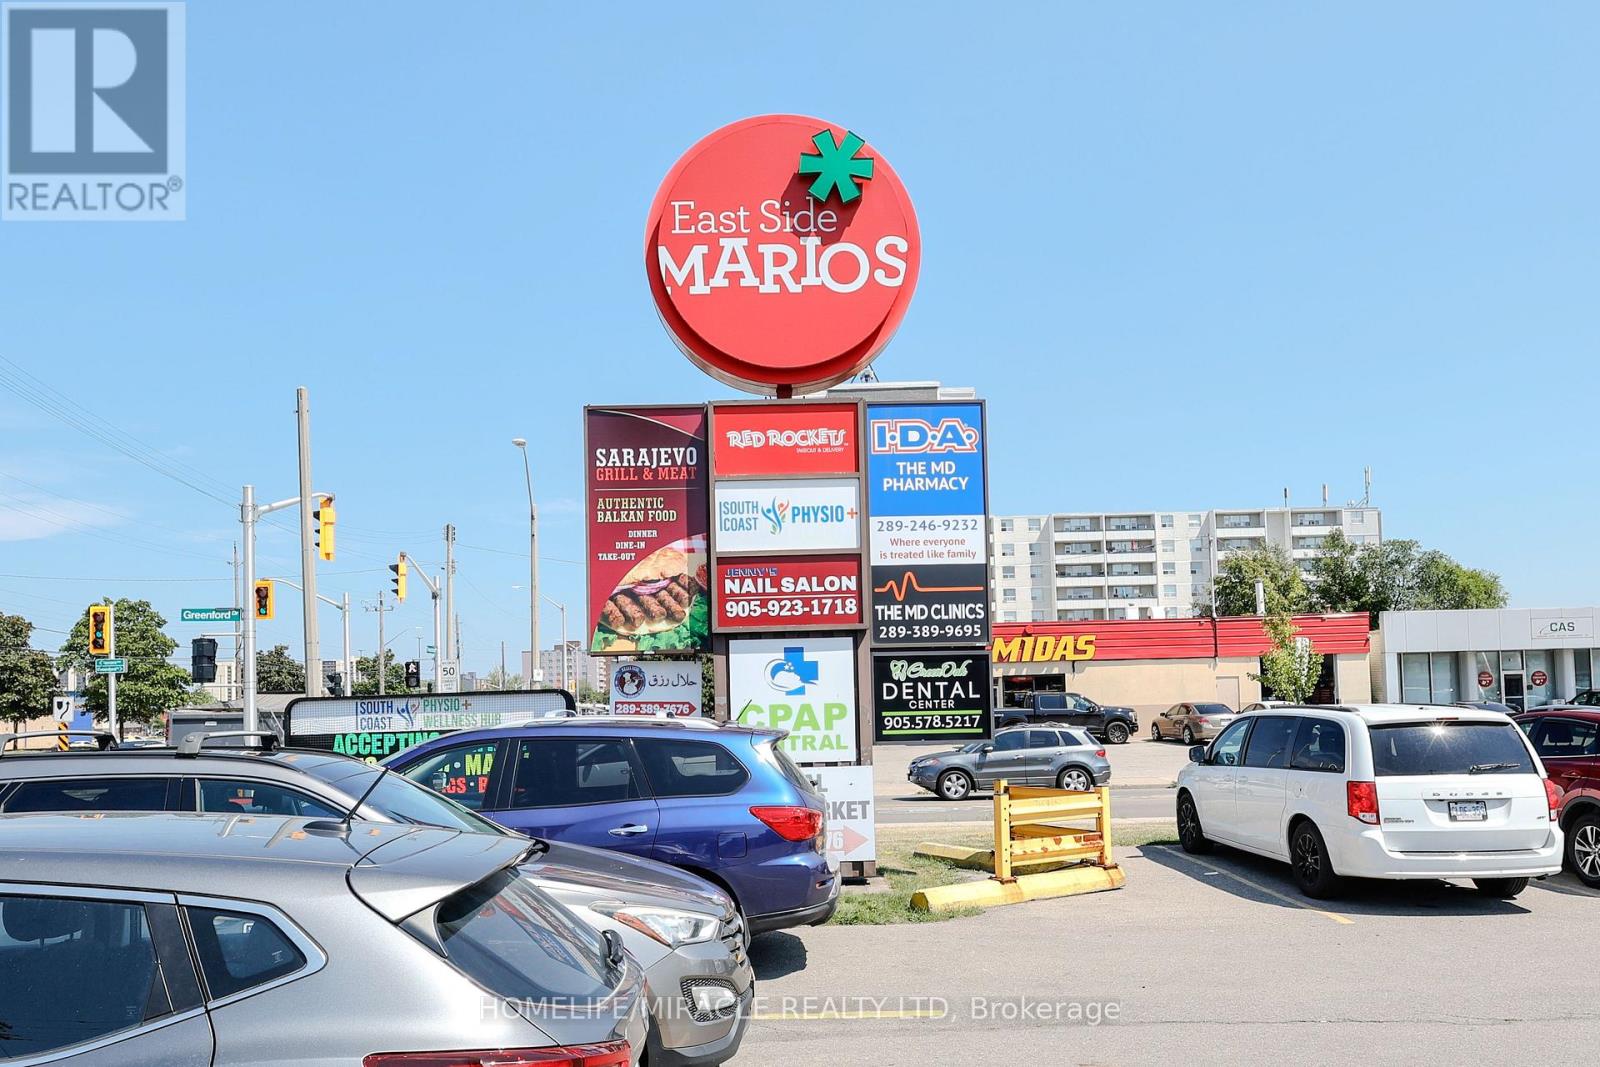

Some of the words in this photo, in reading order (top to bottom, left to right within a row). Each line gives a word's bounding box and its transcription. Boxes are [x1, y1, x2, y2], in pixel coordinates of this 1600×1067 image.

[670, 199, 751, 235] East
[759, 196, 838, 234] Side
[657, 234, 909, 296] MARIOS
[726, 429, 766, 449] RED
[766, 427, 847, 448] ROCKETS
[595, 446, 698, 470] SARAJEVO
[596, 467, 639, 481] GRILL
[642, 467, 654, 480] &
[657, 466, 697, 480] MEAT
[895, 461, 927, 475] THE
[930, 460, 956, 475] MD
[883, 476, 969, 492] PHARMACY
[596, 497, 665, 510] AUTHENTIC
[722, 501, 759, 515] SOUTH
[596, 510, 645, 523] BALKAN
[647, 510, 678, 522] FOOD
[791, 505, 845, 524] PHYSIO
[723, 517, 760, 532] COAST
[876, 519, 979, 532] 289-246-9232
[628, 530, 658, 538] DINNER
[615, 541, 646, 549] DINE-IN
[890, 538, 921, 547] Where
[923, 538, 966, 548] everyone
[880, 551, 888, 560] is
[890, 550, 925, 559] treated
[927, 549, 945, 558] like
[947, 549, 977, 560] family
[725, 567, 778, 578] JENNY'S
[724, 578, 779, 594] NAIL
[780, 575, 857, 593] SALON
[183, 610, 231, 620] Greenford
[725, 598, 857, 618] 905-923-1718
[875, 605, 903, 621] THE
[905, 604, 929, 620] MD
[930, 603, 985, 620] CLINICS
[879, 624, 982, 639] 289-389-9695
[1549, 621, 1576, 632] CAS
[992, 634, 1097, 663] MIDAS
[442, 667, 455, 676] 50
[882, 681, 981, 700] DENTAL
[360, 701, 393, 715] SOUTH
[423, 698, 460, 712] PHYSIO
[615, 703, 690, 714] 289-389-7676
[908, 699, 955, 709] CENTER
[360, 716, 393, 731] COAST
[423, 714, 478, 729] WELLNESS
[738, 702, 848, 731] CPAP
[884, 715, 980, 729] 905.578.5217
[780, 734, 848, 751] TRAL
